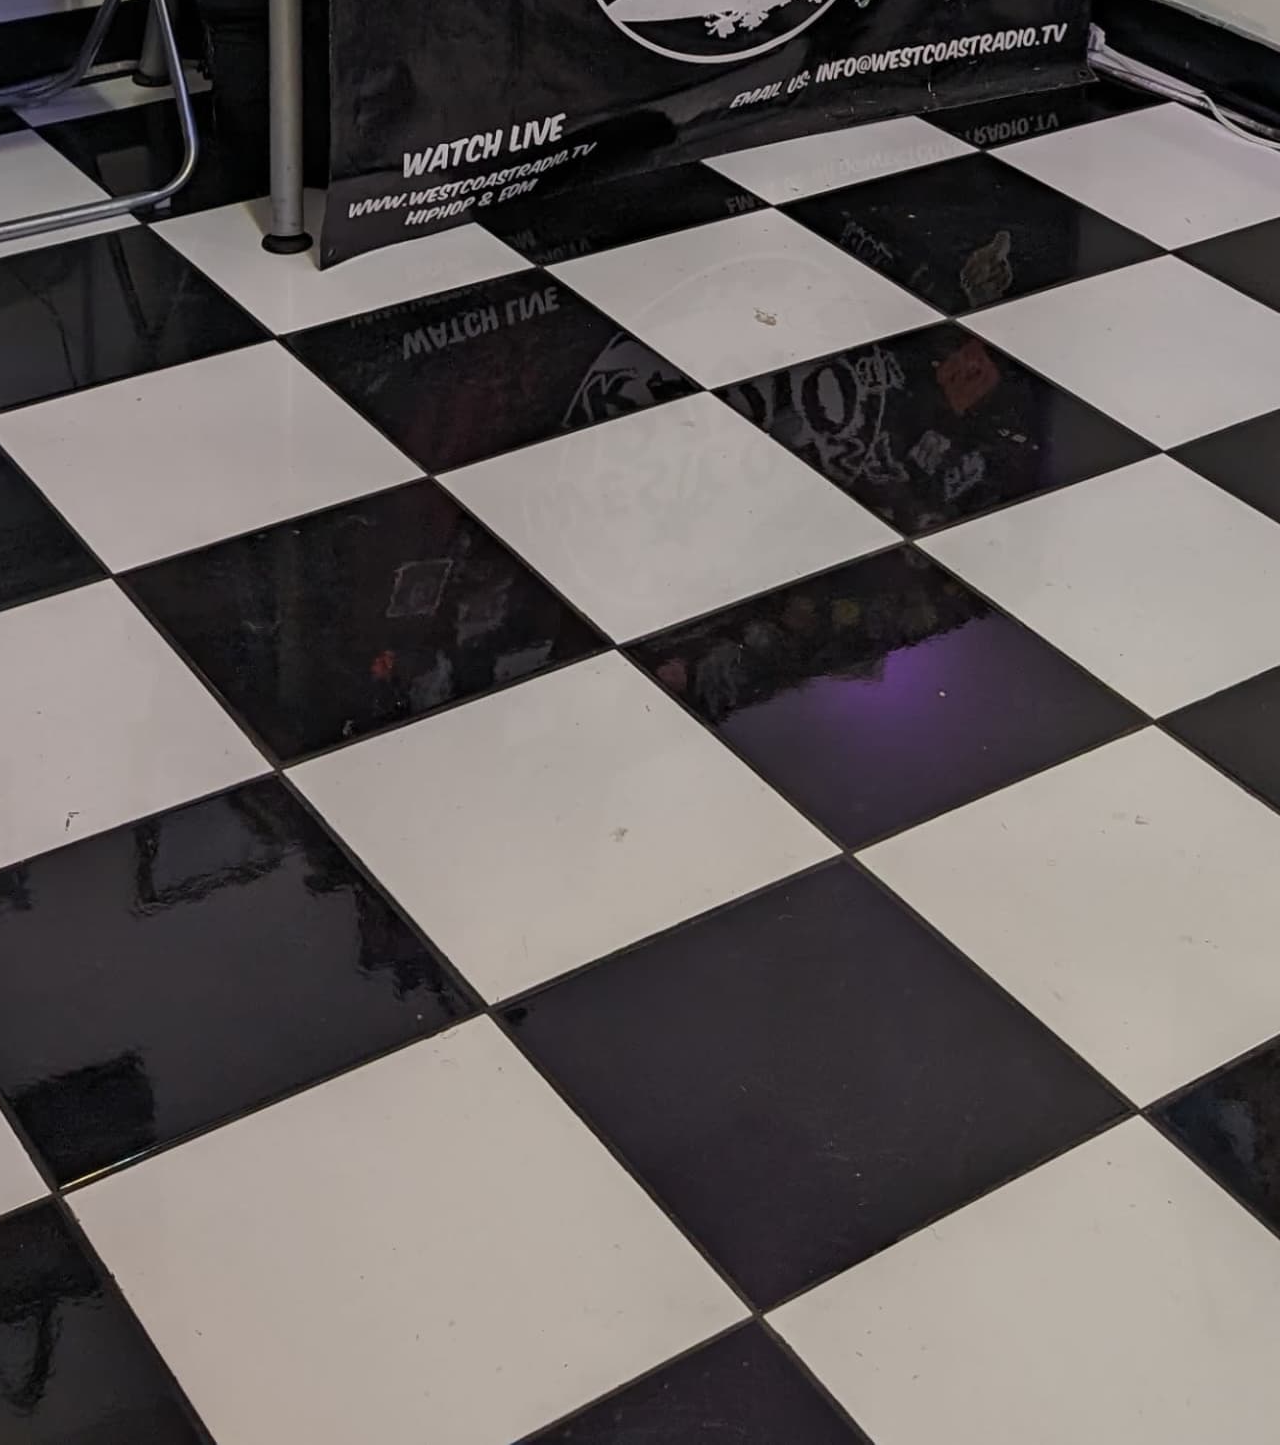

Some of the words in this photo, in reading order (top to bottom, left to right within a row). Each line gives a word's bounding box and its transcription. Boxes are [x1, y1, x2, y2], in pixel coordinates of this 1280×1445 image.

[729, 80, 782, 109] EMAIL
[815, 23, 1068, 83] INFO@WESTCOASTRADIO.TV
[403, 129, 503, 178] WATCH
[509, 112, 566, 152] LIVE
[404, 196, 476, 226] HIPHOP
[477, 191, 493, 207] &
[498, 178, 539, 203] EDM
